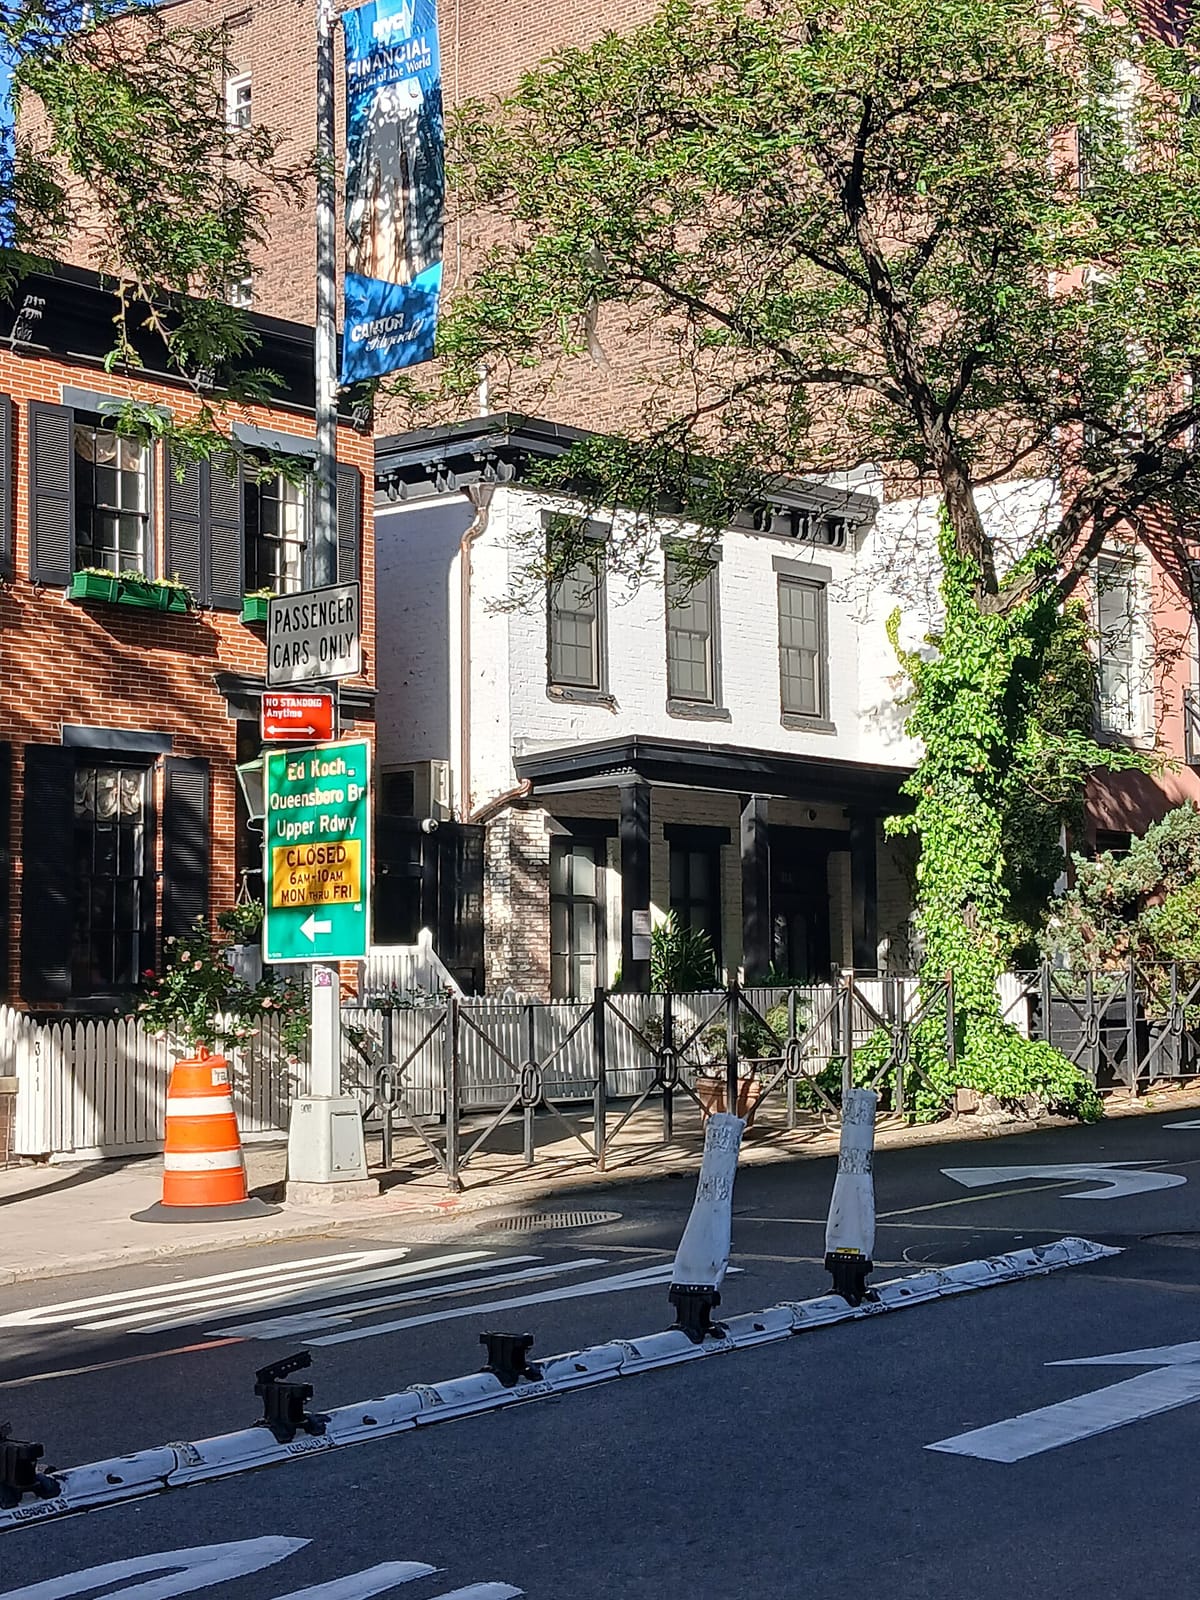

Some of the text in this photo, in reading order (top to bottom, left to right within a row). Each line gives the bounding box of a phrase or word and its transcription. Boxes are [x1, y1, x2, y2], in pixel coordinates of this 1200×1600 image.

[348, 36, 431, 77] FINANCIAL
[377, 70, 387, 83] of
[388, 66, 404, 80] the
[405, 54, 432, 74] World
[274, 597, 354, 634] PASSENGER
[273, 633, 354, 669] CARS ONLY
[266, 697, 323, 708] NO STANDING
[266, 708, 303, 719] Anytime
[287, 762, 305, 781] Ed
[270, 783, 365, 810] Queensboro Br
[277, 814, 357, 840] Upper Rdwy
[286, 845, 346, 867] CLOSED
[281, 884, 352, 902] MON THRU FRI
[34, 1041, 42, 1092] 311
